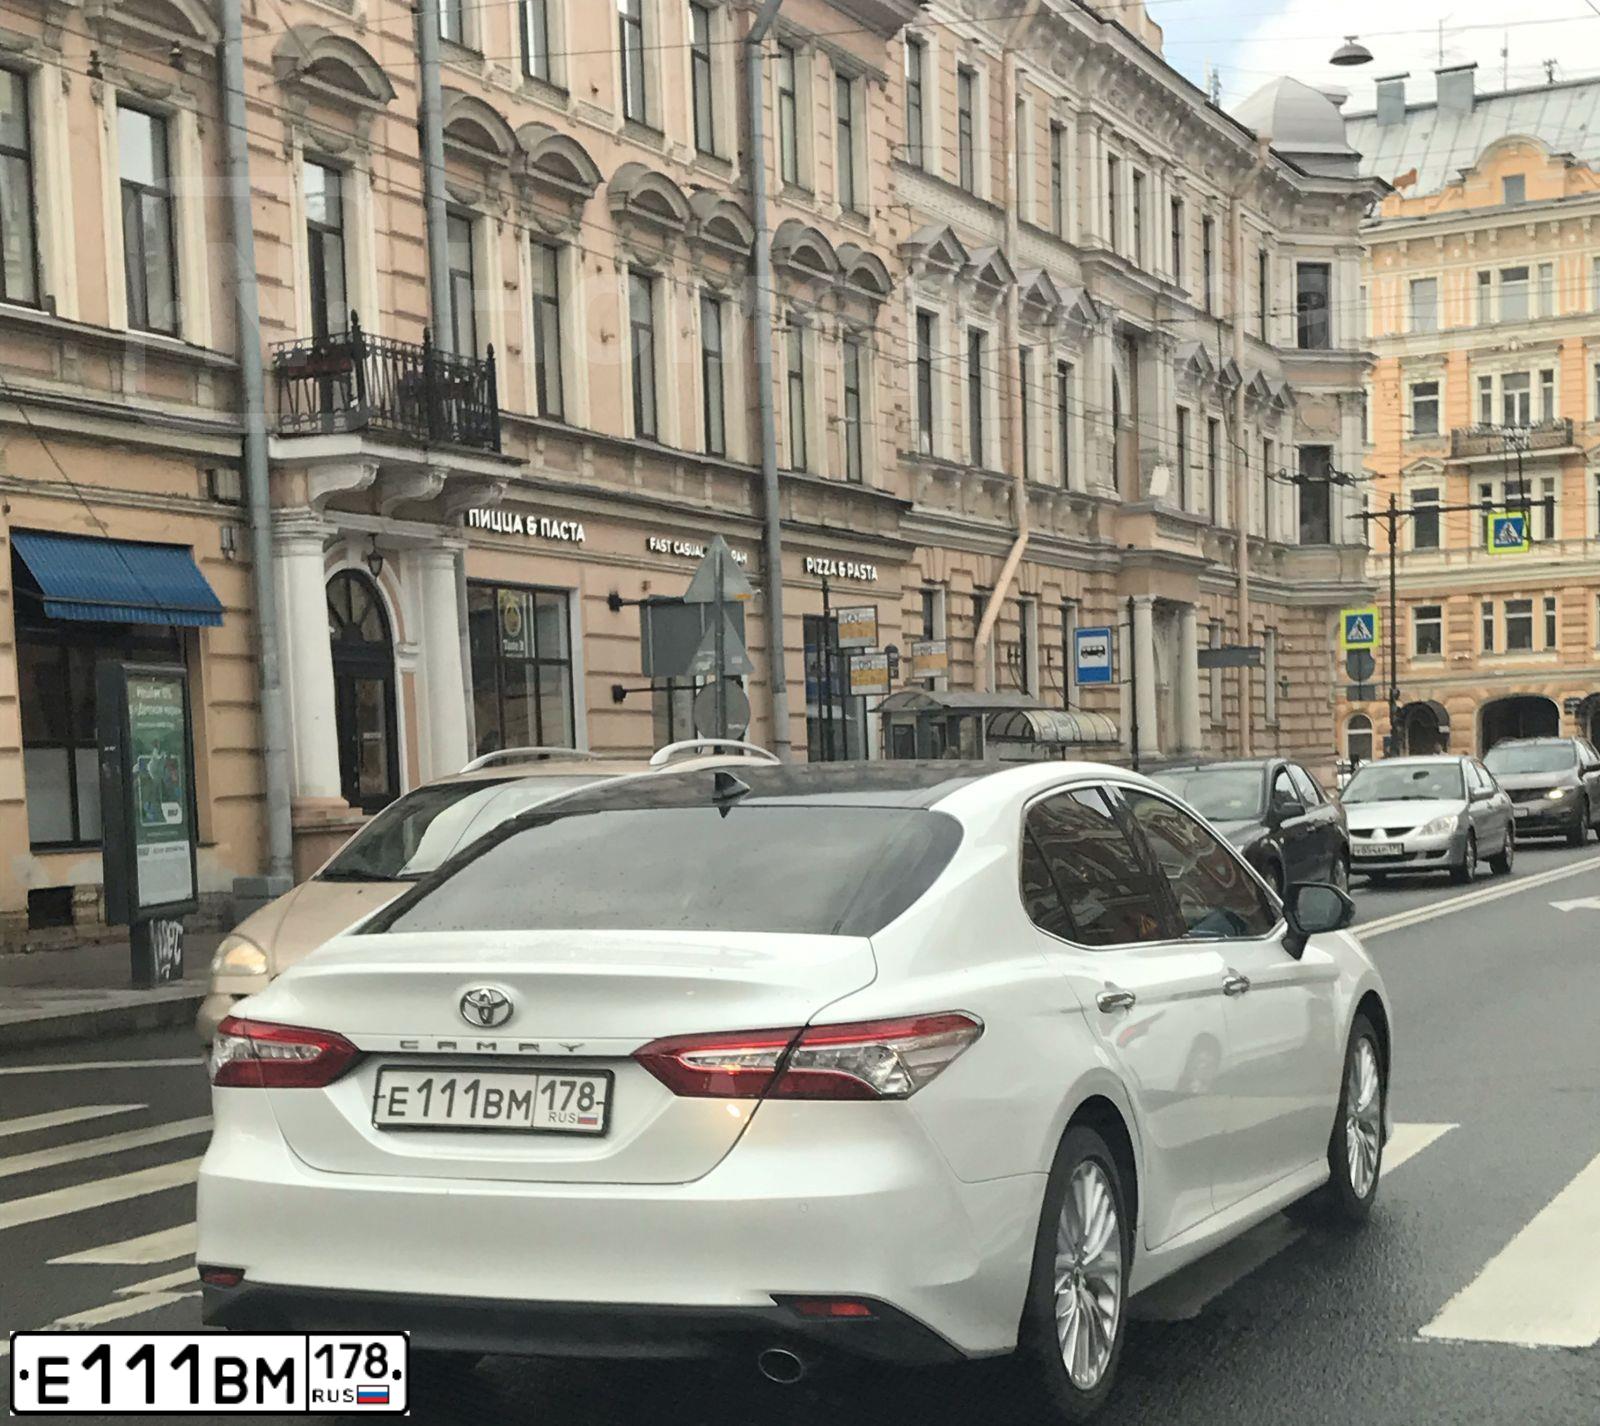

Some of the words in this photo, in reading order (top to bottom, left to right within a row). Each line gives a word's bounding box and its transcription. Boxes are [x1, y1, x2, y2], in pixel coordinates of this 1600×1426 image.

[468, 508, 524, 534] ПИЦЦА
[540, 518, 586, 542] ПАСТА
[649, 536, 672, 553] FAST
[673, 541, 706, 559] CASUAL
[806, 556, 838, 576] PIZZA
[847, 562, 879, 581] PASTA
[400, 1040, 586, 1053] CAMRY
[540, 1079, 596, 1112] 178
[548, 1111, 577, 1124] RUS
